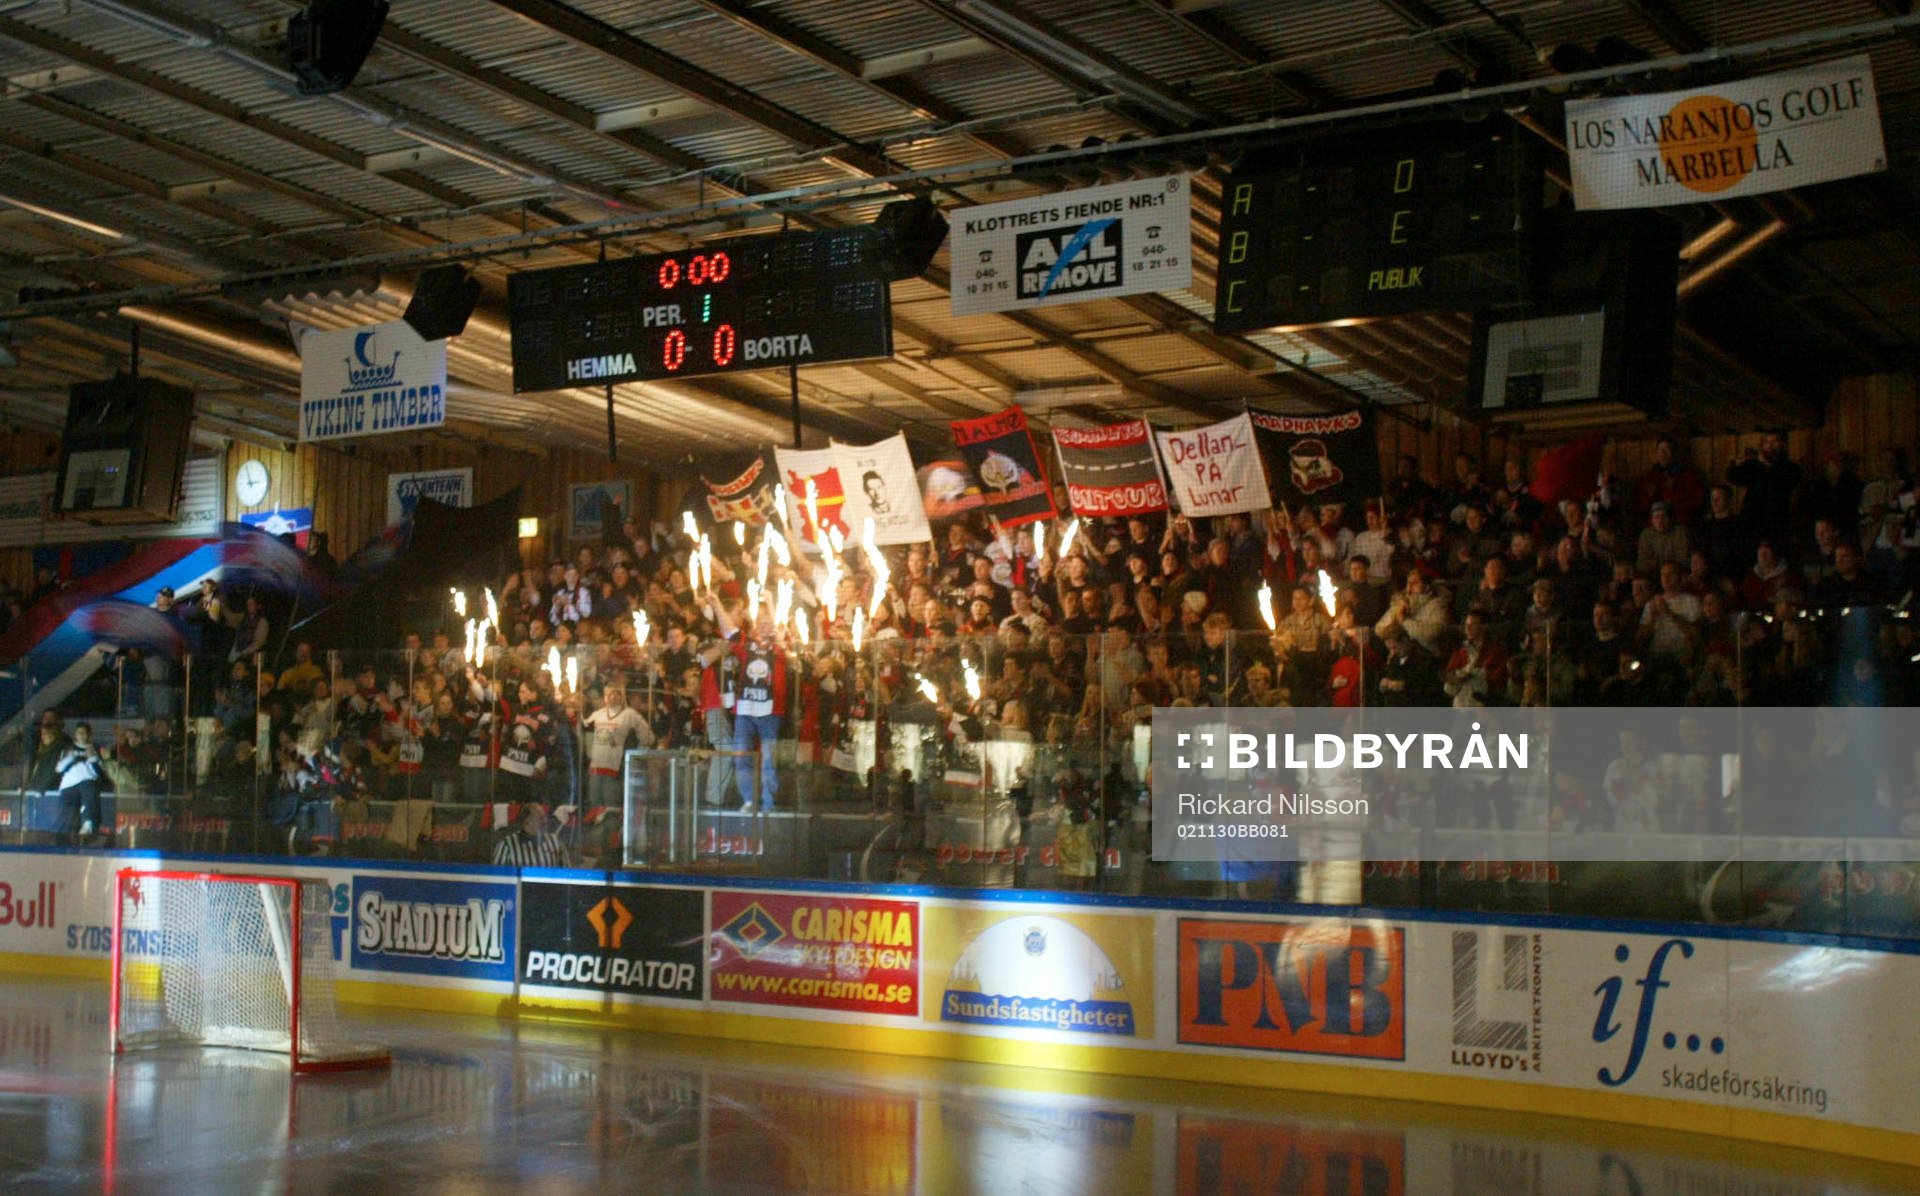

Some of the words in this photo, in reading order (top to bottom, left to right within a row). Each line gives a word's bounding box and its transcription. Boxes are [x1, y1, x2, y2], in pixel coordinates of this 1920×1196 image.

[1571, 119, 1616, 149] LOS
[1621, 99, 1773, 145] NARANJOS
[1780, 77, 1865, 122] GOLF
[1636, 138, 1794, 187] MARBELLA
[966, 209, 1060, 235] KLOTTRETS
[1065, 199, 1123, 220] FIENDE
[1232, 183, 1253, 216] A
[1023, 260, 1117, 294] REMOVE
[1368, 266, 1423, 291] PUBLIK
[642, 304, 687, 328] PER.
[567, 353, 637, 380] HEMMA
[743, 334, 814, 361] BORTA
[304, 395, 365, 438] VIKING
[372, 385, 443, 430] TIMBER
[1189, 484, 1245, 507] Lunar
[1040, 838, 1121, 869] cln
[0, 880, 56, 929] Bull
[357, 891, 505, 963] STADIUM
[791, 906, 913, 947] CARISMA
[526, 950, 696, 992] PROCURATOR
[717, 969, 912, 1005] www.carisma.se
[1191, 937, 1392, 1037] PNB
[947, 998, 1129, 1031] Sundsfastigheter
[1532, 933, 1543, 1073] ARKITEKTKONTOR
[1451, 1050, 1529, 1073] LLOYD's
[1661, 1064, 1828, 1114] skadeförsäkring
